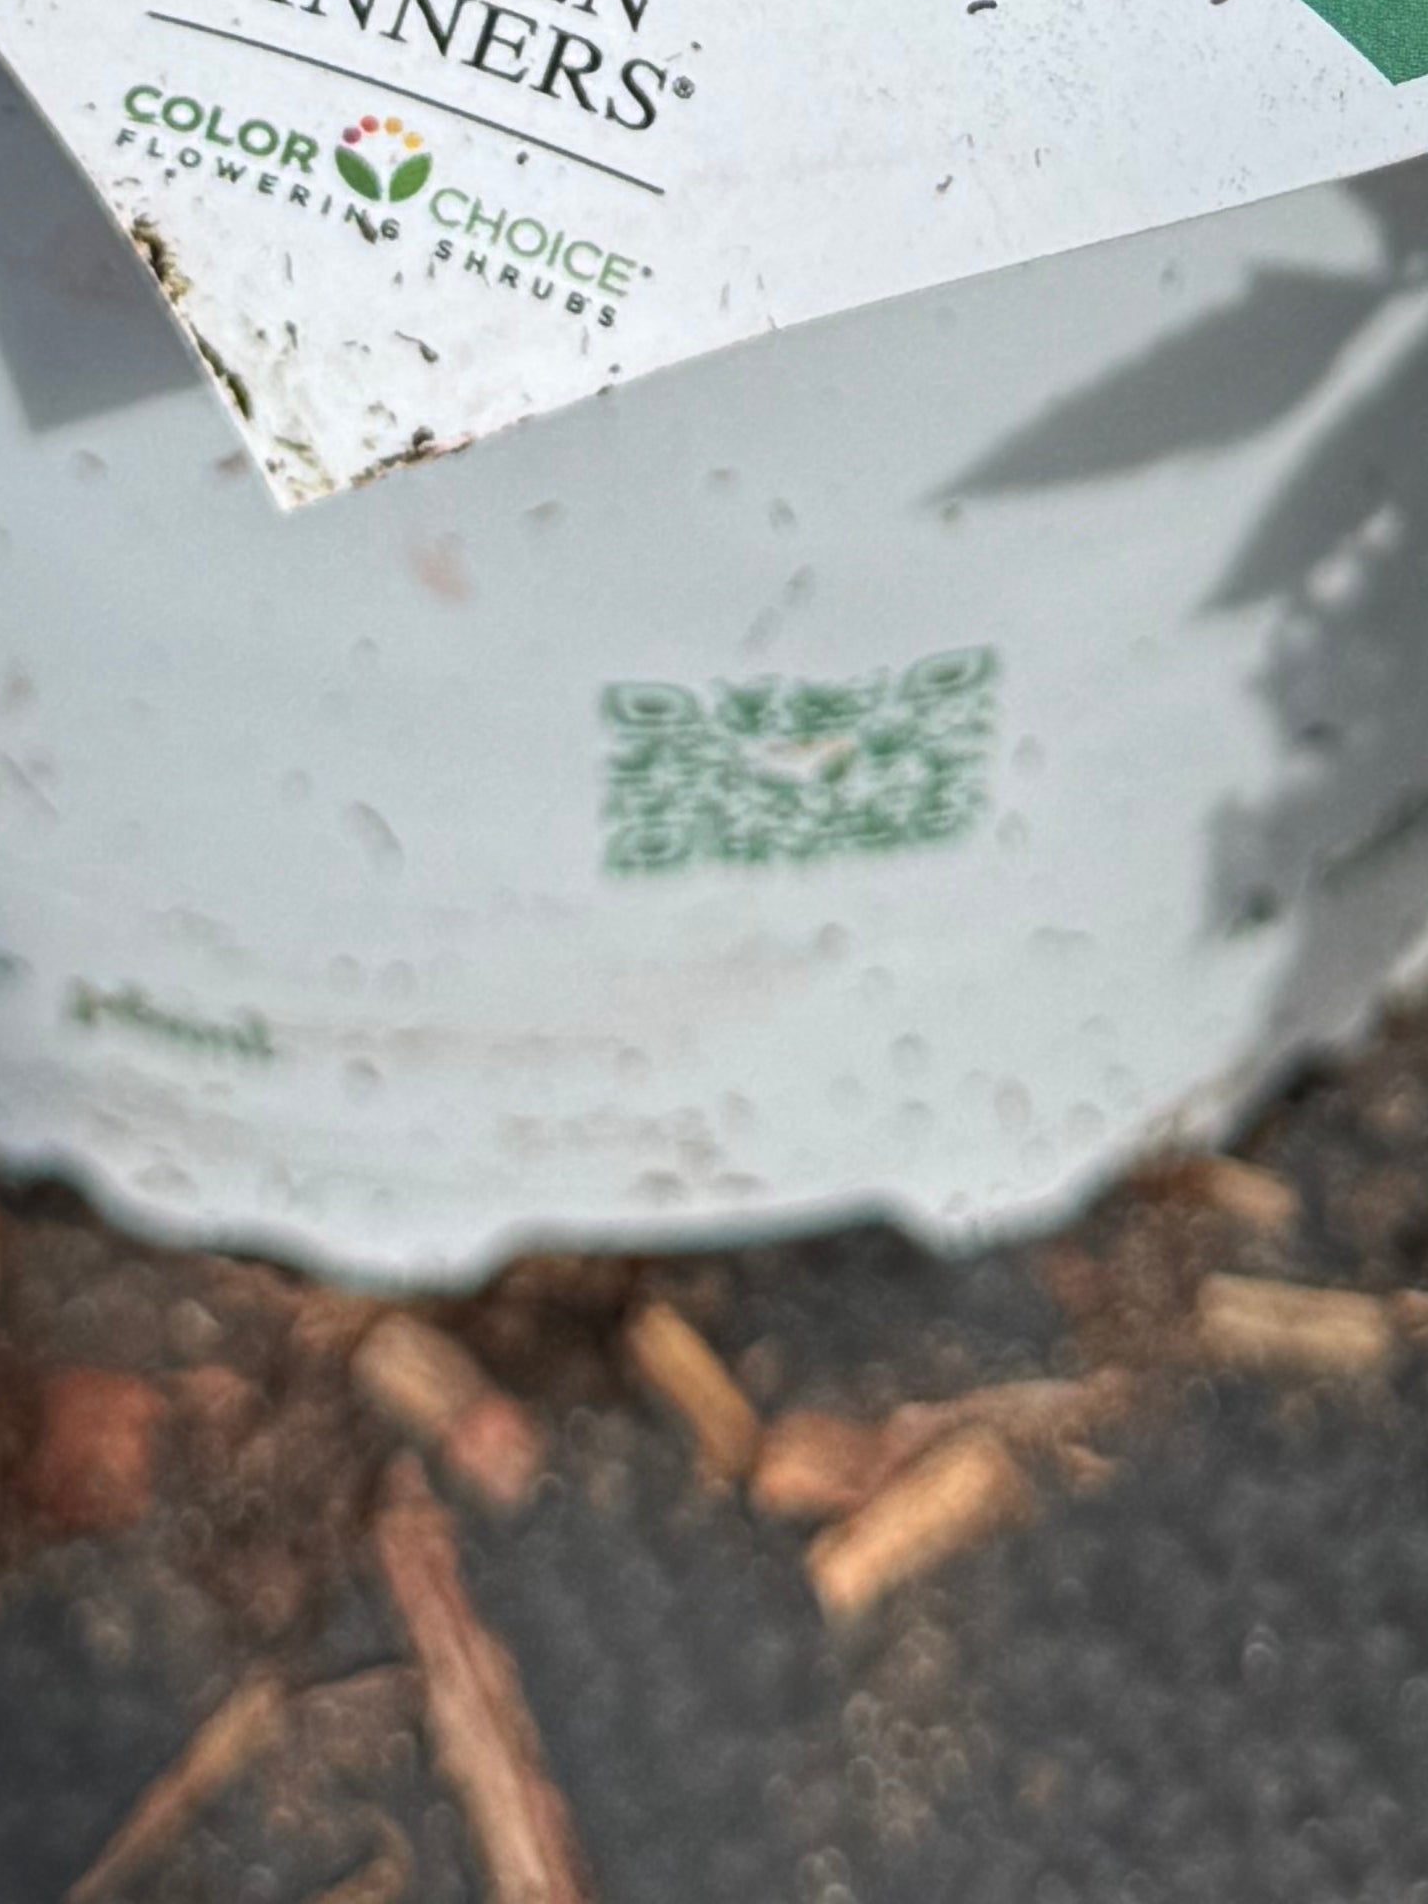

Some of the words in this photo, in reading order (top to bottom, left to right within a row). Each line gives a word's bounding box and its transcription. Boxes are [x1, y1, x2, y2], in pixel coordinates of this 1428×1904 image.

[122, 83, 320, 174] COLOR
[114, 127, 401, 242] FLOWERING
[433, 238, 619, 329] SHRUBS
